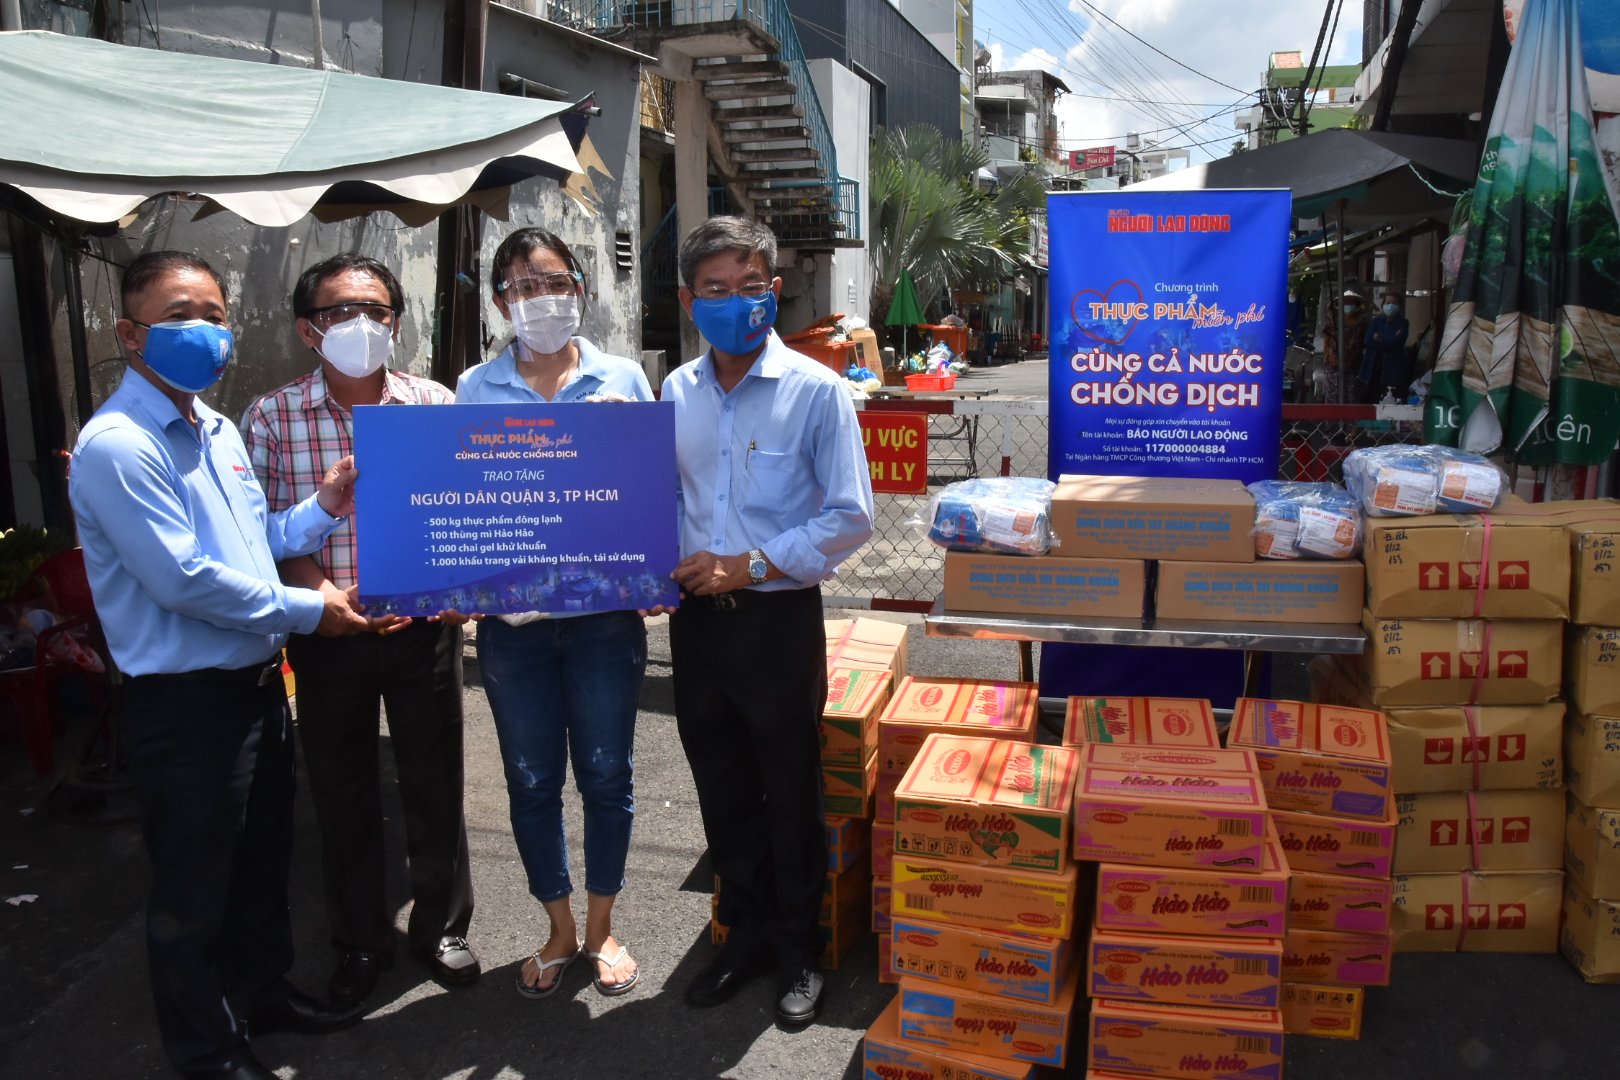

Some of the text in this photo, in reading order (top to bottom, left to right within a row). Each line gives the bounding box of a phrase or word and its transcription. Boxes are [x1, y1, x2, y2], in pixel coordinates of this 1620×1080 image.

[1156, 215, 1186, 232] LAO
[1154, 282, 1218, 294] Chương trình
[1089, 294, 1218, 325] THỰC PHẨM
[1234, 303, 1266, 329] phí
[1070, 346, 1263, 374] CÙNG CẢ NƯỚC
[1070, 372, 1260, 412] CHỐNG DỊCH
[470, 434, 506, 447] THỰC
[860, 425, 918, 452] U VỰC
[1126, 428, 1150, 438] BÁO
[1152, 428, 1188, 439] NGƯỜI
[1190, 430, 1212, 440] LAO
[1214, 429, 1248, 442] ĐỘNG
[456, 448, 578, 460] CÙNG CẢ NƯỚC CHỐNG DỊCH
[1145, 444, 1226, 454] 117000004884
[483, 468, 545, 482] TRAO TẶNG
[871, 462, 916, 482] H LY
[411, 489, 618, 506] NGƯỜI DÂN QUẬN 3, TP HCM
[430, 514, 562, 528] 500 kg thực phẩm đông lạnh
[430, 528, 534, 540] 100 thùng mì Hảo Hảo
[430, 540, 546, 554] 1.000 chai gel khử khuẩn
[431, 552, 645, 566] 1.000 khẩu trang vải kháng khuẩn, tái sử dụng
[1120, 775, 1219, 788] Hảo Hảo
[1276, 770, 1342, 789] Hảo Hảo
[944, 812, 1016, 832] Hảo Hảo
[1165, 834, 1224, 852] Hảo Hảo
[1306, 833, 1341, 853] Hảo
[1152, 891, 1230, 915] Hảo Hảo
[975, 957, 1038, 977] Hảo Hảo
[1140, 962, 1229, 987] Hảo Hảo
[1178, 1053, 1248, 1072] Hảo Hảo
